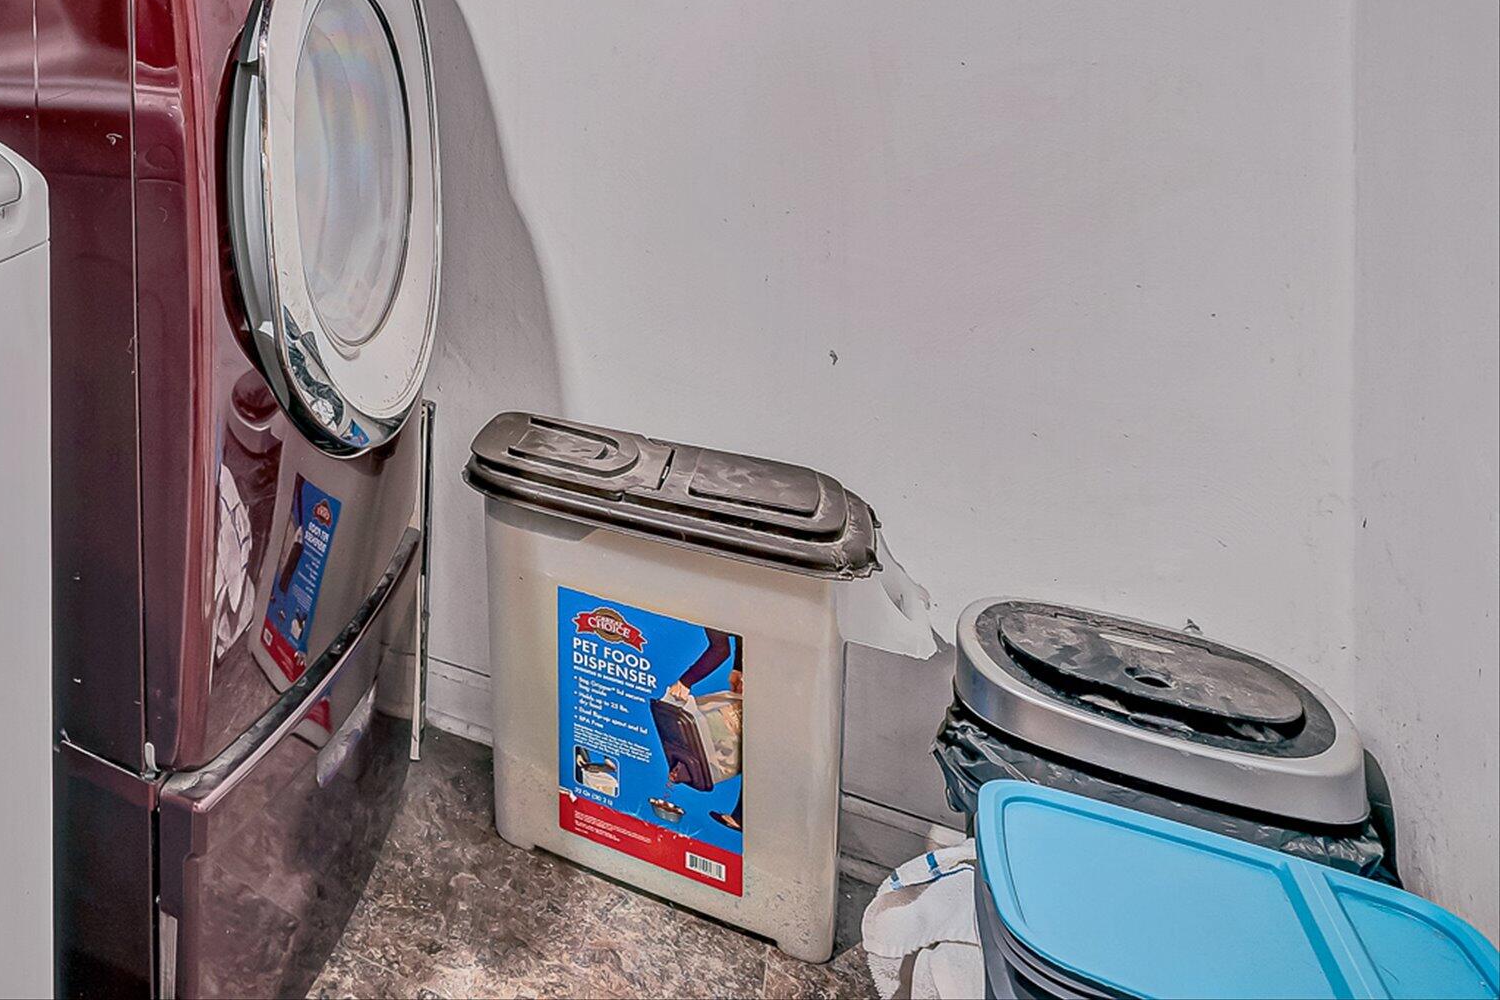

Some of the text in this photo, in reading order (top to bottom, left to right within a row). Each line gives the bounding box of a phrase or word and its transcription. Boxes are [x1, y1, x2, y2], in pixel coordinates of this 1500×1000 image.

[587, 617, 632, 639] CHOICE
[573, 636, 651, 671] PET FOOD
[573, 650, 657, 688] DISPENSER
